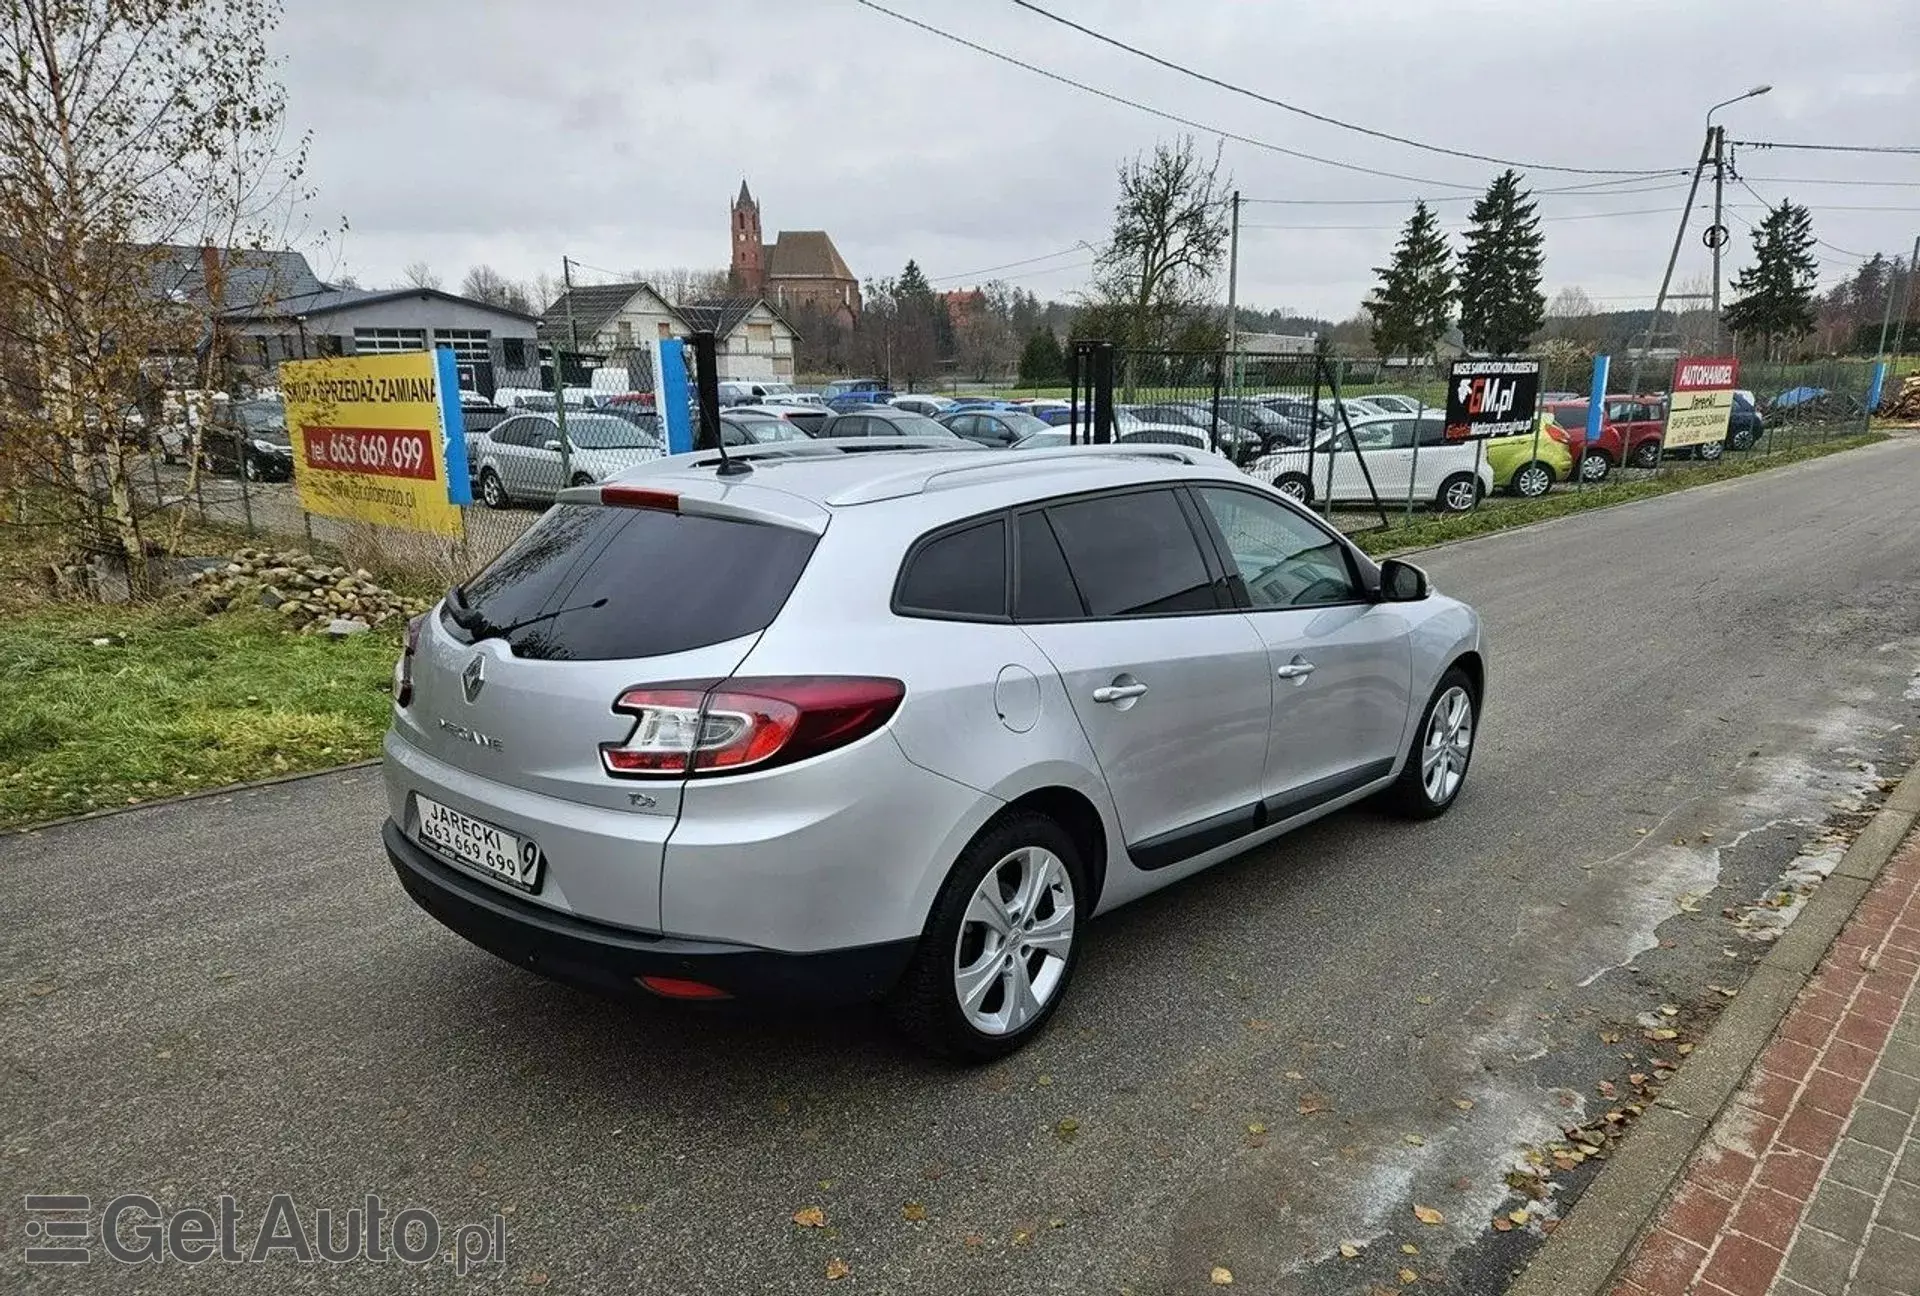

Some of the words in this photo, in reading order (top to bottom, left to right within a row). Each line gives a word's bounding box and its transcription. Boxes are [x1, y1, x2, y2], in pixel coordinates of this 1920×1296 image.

[318, 375, 376, 403] SPRZEDAŻ
[1680, 366, 1733, 385] AUTOHANDEL
[1469, 378, 1517, 420] GM.pl
[330, 433, 357, 465] 663
[360, 435, 388, 467] 669
[392, 437, 423, 470] 699
[430, 804, 501, 851] JARECKI
[425, 820, 451, 844] 663
[455, 834, 480, 859] 669
[486, 850, 516, 876] 699
